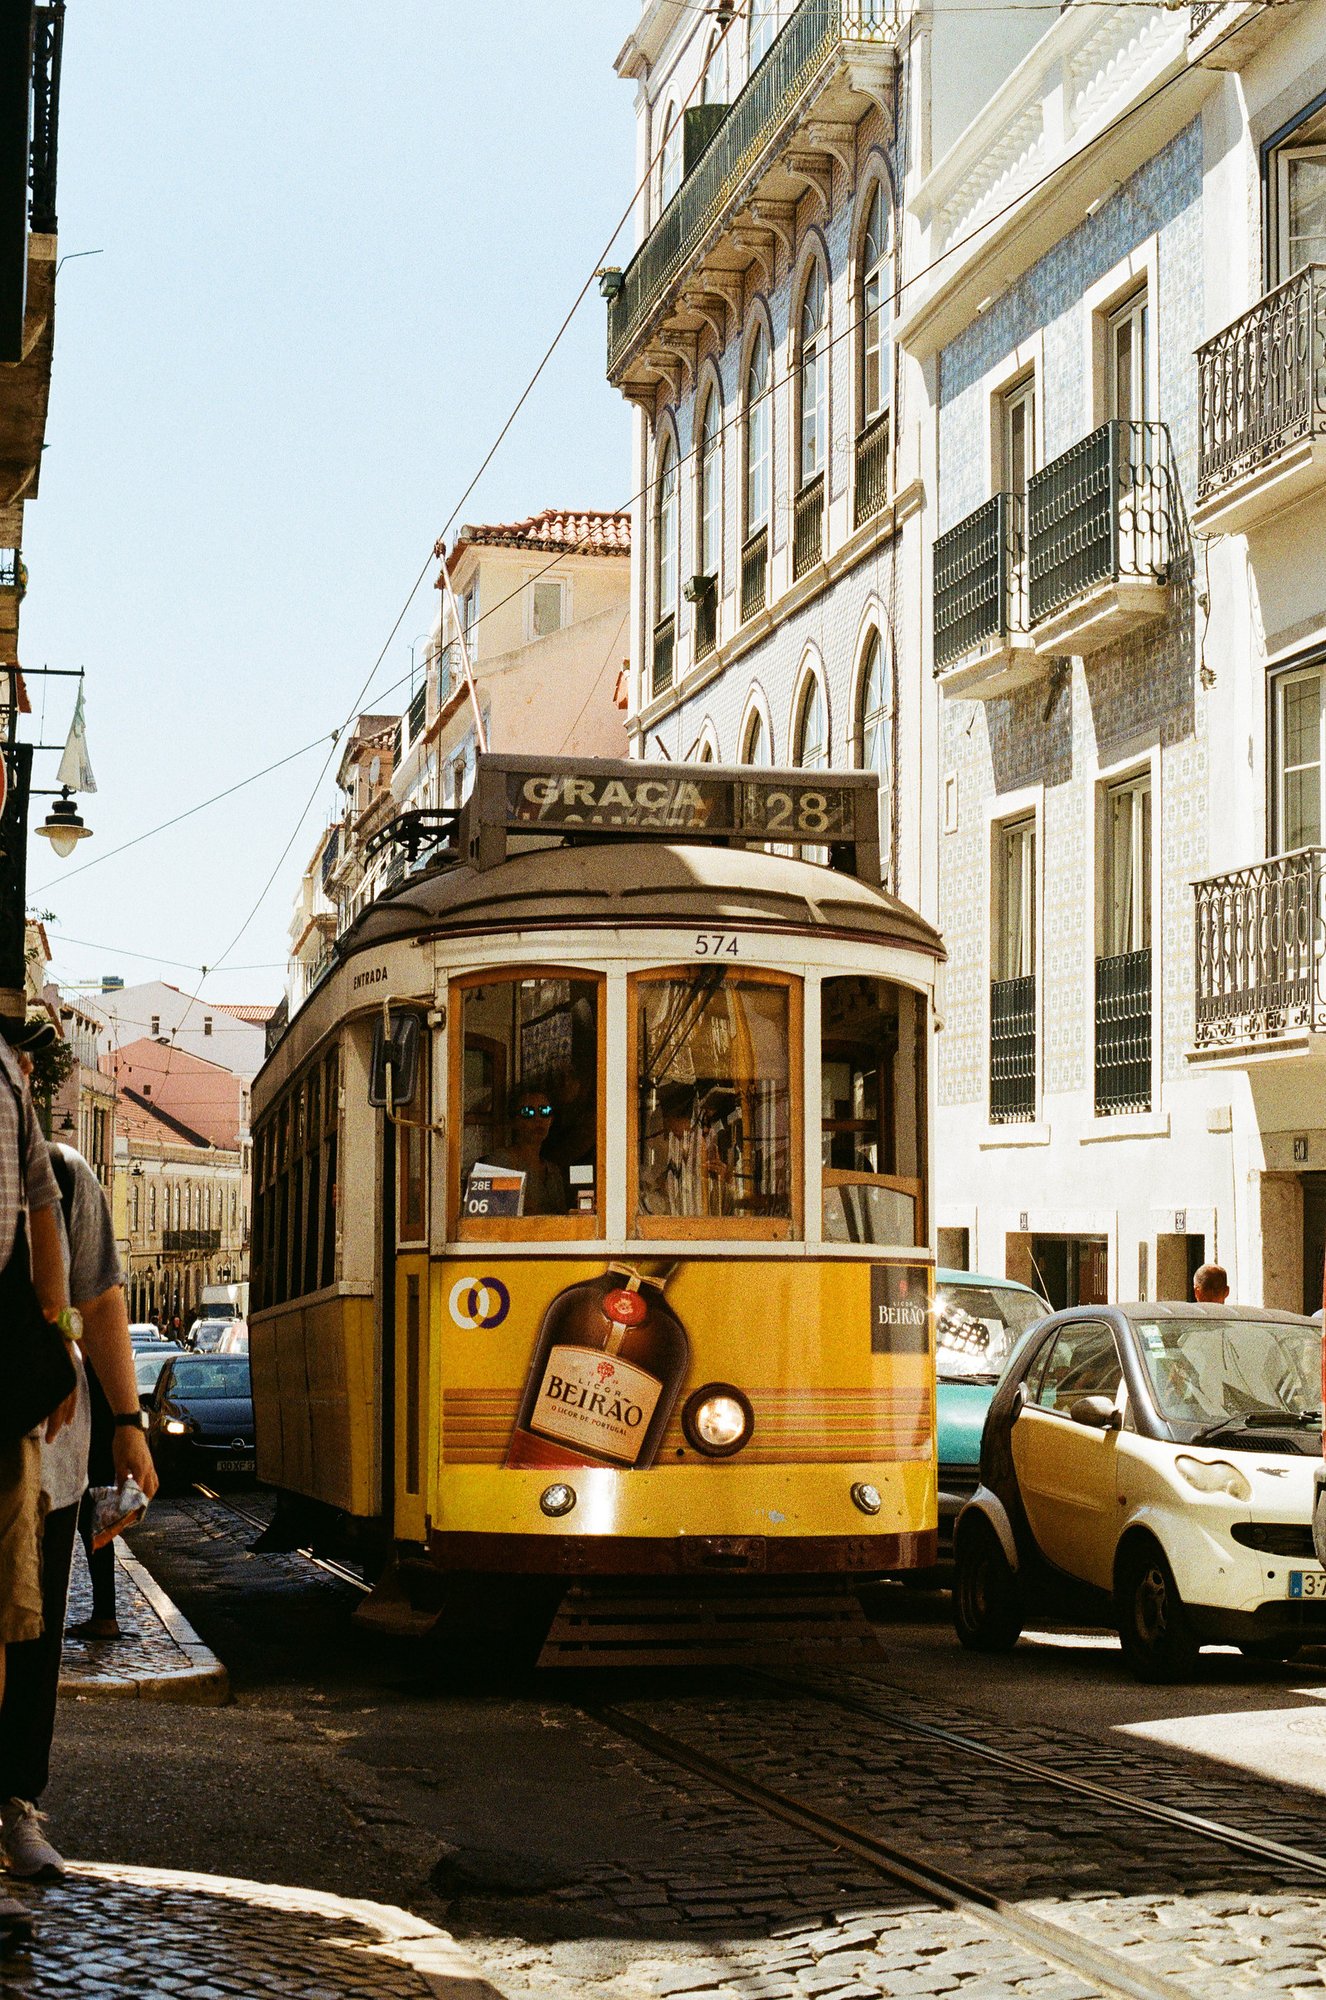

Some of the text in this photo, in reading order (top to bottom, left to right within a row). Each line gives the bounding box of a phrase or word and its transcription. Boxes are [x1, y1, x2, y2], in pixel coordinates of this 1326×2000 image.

[522, 777, 706, 811] GRAÇA
[766, 791, 829, 832] 28
[695, 935, 739, 956] 574
[353, 966, 388, 990] ENTRADA
[471, 1181, 491, 1191] 28E
[468, 1199, 489, 1213] 06
[878, 1305, 925, 1325] BEIRÃO
[578, 1377, 622, 1397] LICOR
[545, 1374, 643, 1427] BEIRÃO
[557, 1407, 578, 1419] LICOR
[580, 1414, 589, 1422] DE
[591, 1418, 627, 1437] PORTUGAL
